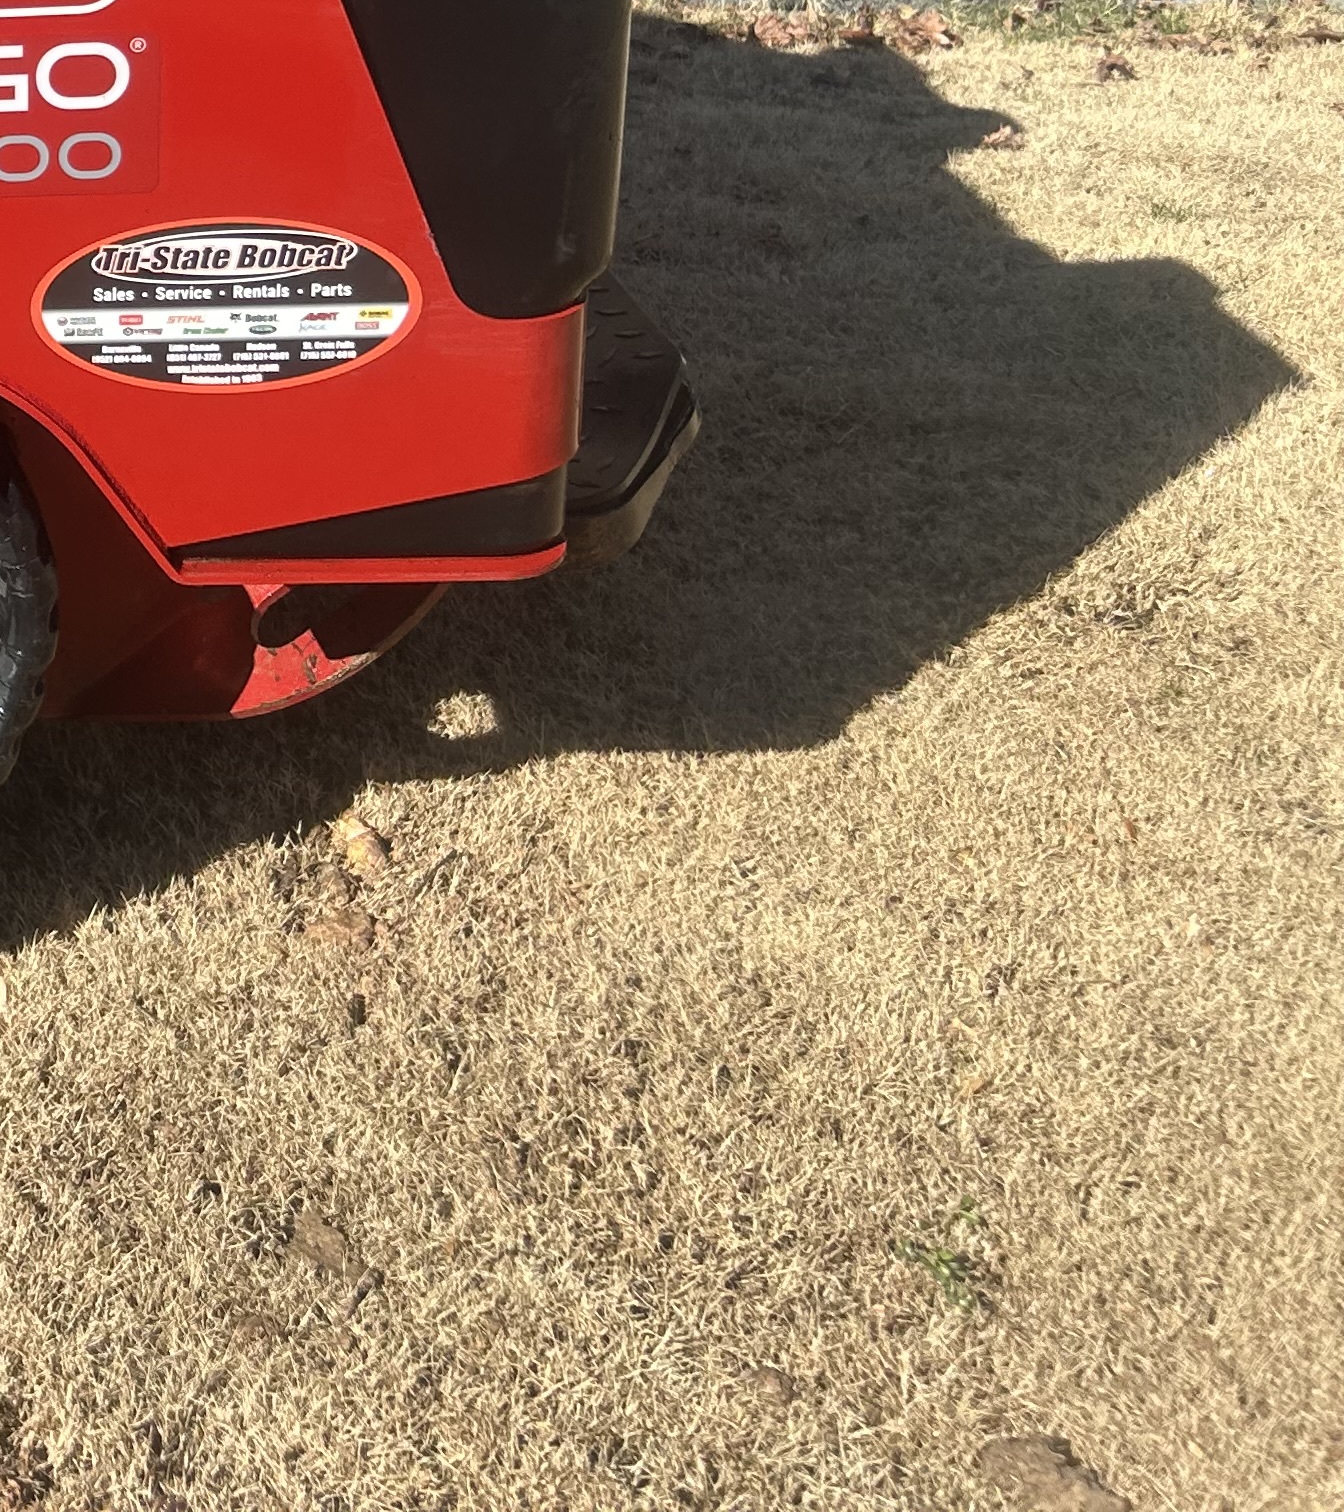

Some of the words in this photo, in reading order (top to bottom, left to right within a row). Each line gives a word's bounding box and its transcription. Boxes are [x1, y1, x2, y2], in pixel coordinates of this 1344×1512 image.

[100, 245, 230, 273] Tri-State
[236, 243, 348, 270] Bobcat
[93, 287, 135, 302] Sales
[155, 285, 212, 301] Service
[232, 284, 290, 299] Rentals
[310, 283, 353, 298] Parts
[166, 315, 206, 324] STIHL
